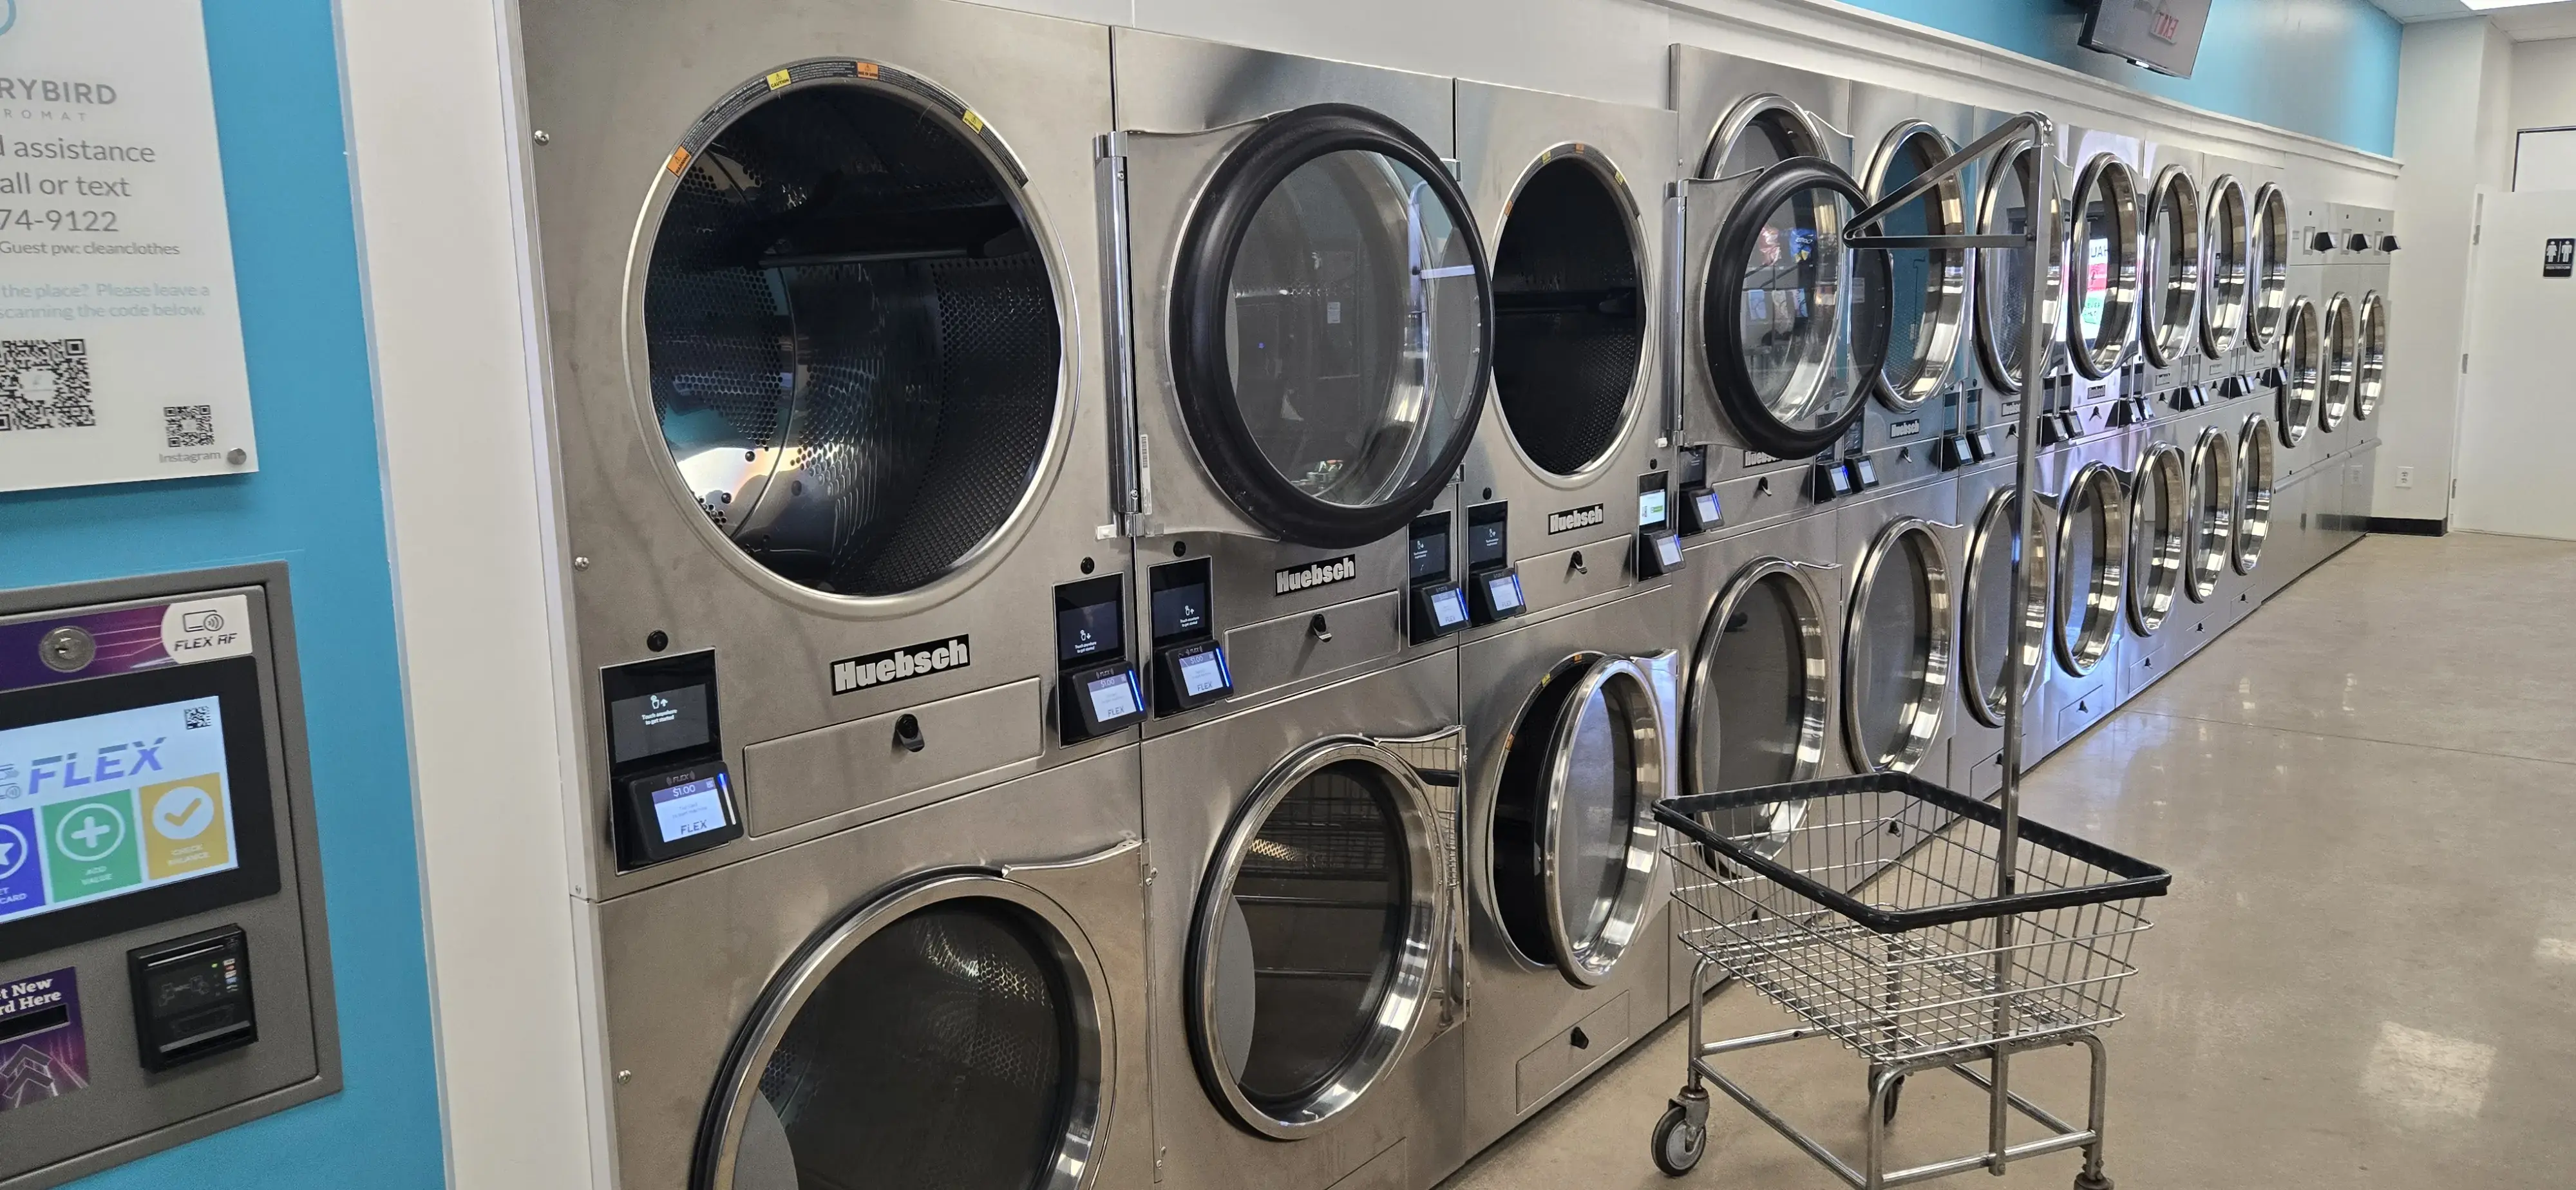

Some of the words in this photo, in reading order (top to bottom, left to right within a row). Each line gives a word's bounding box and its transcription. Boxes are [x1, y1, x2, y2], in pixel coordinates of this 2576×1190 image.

[0, 78, 117, 105] RYBIRD
[770, 78, 790, 88] CAUTION
[14, 137, 156, 162] assistance
[676, 153, 690, 174] WARNING
[39, 178, 69, 195] or
[76, 176, 132, 197] text
[0, 241, 48, 254] Guest
[52, 245, 80, 256] pw:
[84, 241, 180, 255] cleanclothes
[1, 283, 32, 298] the
[35, 283, 90, 300] place?
[97, 283, 152, 297] Please
[154, 281, 198, 297] leave
[200, 286, 211, 297] a
[77, 303, 106, 317] the
[108, 303, 150, 317] code
[153, 302, 205, 317] below.
[159, 451, 222, 464] Instagram
[1549, 505, 1604, 534] Huebsch
[1276, 556, 1355, 594] Huebsch
[174, 636, 213, 652] FLEX
[217, 632, 238, 646] RF
[833, 639, 968, 694] Huebsch
[1100, 678, 1115, 688] $1.00
[1197, 681, 1213, 692] FLEX
[1108, 705, 1125, 718] FLEX
[28, 736, 167, 796] FLEX
[672, 773, 690, 784] FLEX
[672, 784, 696, 798] $1.00
[681, 819, 708, 835] FLEX
[12, 978, 53, 997] New
[19, 991, 62, 1010] Here
